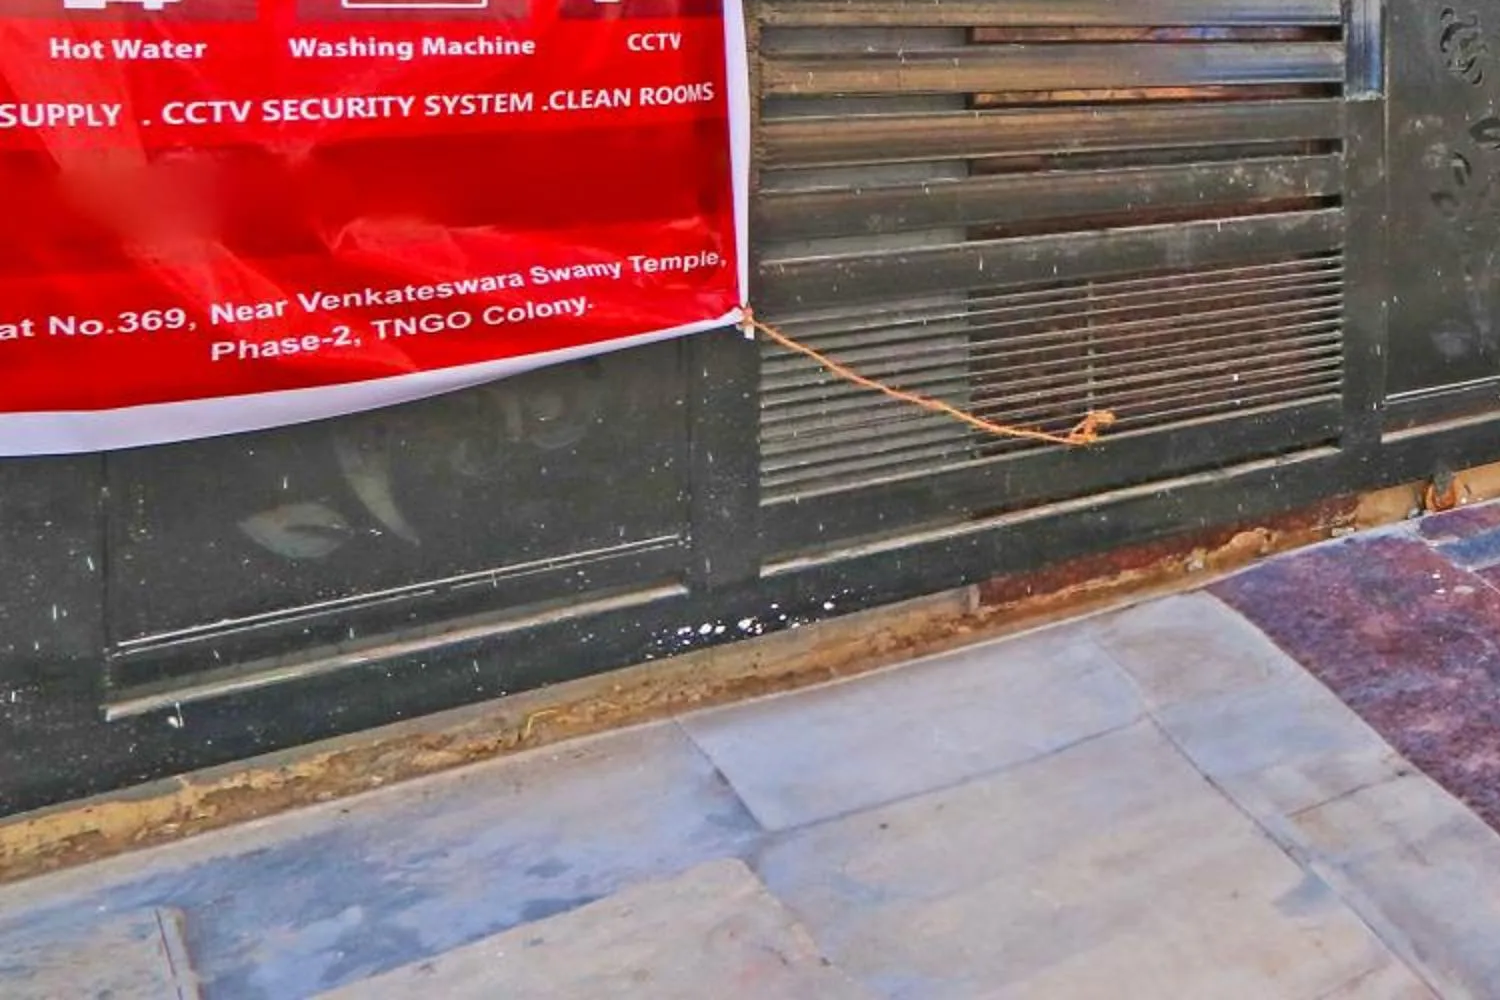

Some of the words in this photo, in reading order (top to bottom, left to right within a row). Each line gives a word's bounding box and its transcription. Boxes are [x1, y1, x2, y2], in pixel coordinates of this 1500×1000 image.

[50, 37, 104, 60] Hot
[112, 38, 207, 60] Water
[288, 37, 414, 61] Washing
[422, 36, 536, 57] Machine
[627, 32, 681, 52] CCTV
[0, 103, 121, 129] SUPPLY
[161, 100, 252, 126] CCTV
[262, 94, 415, 122] SECURITY
[424, 92, 534, 117] SYSTEM
[640, 81, 714, 106] ROOMS
[49, 307, 197, 337] No.369,
[210, 299, 289, 325] Near
[297, 271, 525, 313] Venkateswara
[530, 259, 622, 286] Swamy
[628, 250, 727, 275] Temple,
[211, 324, 361, 362] Phase-2,
[370, 310, 472, 340] TNGO
[483, 294, 594, 327] Colony.
